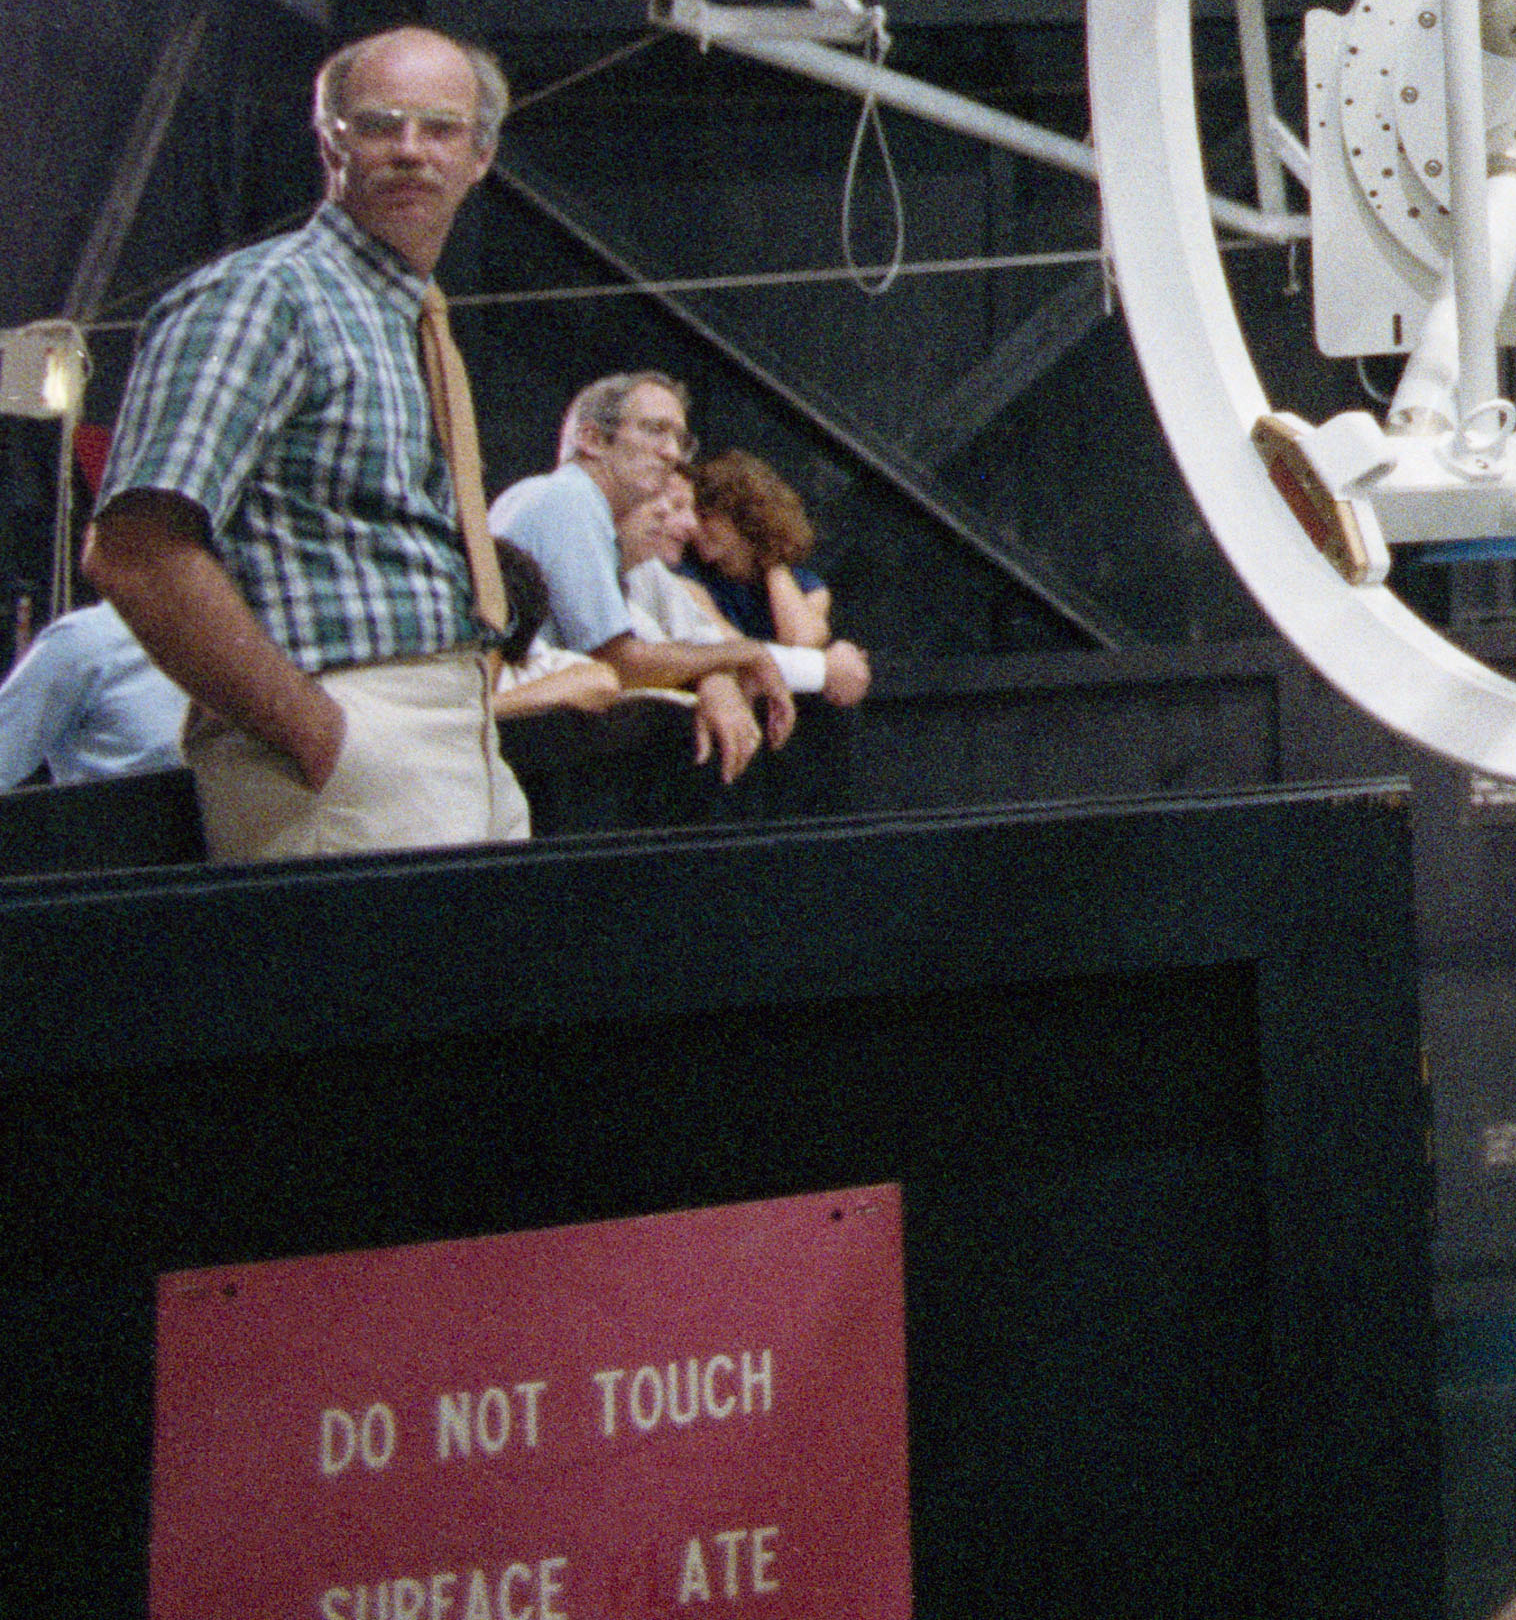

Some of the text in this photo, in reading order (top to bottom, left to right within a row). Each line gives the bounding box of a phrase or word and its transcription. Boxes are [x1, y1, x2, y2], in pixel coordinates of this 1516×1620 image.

[320, 1349, 773, 1475] DO NOT TOUCH
[678, 1526, 780, 1604] ATE
